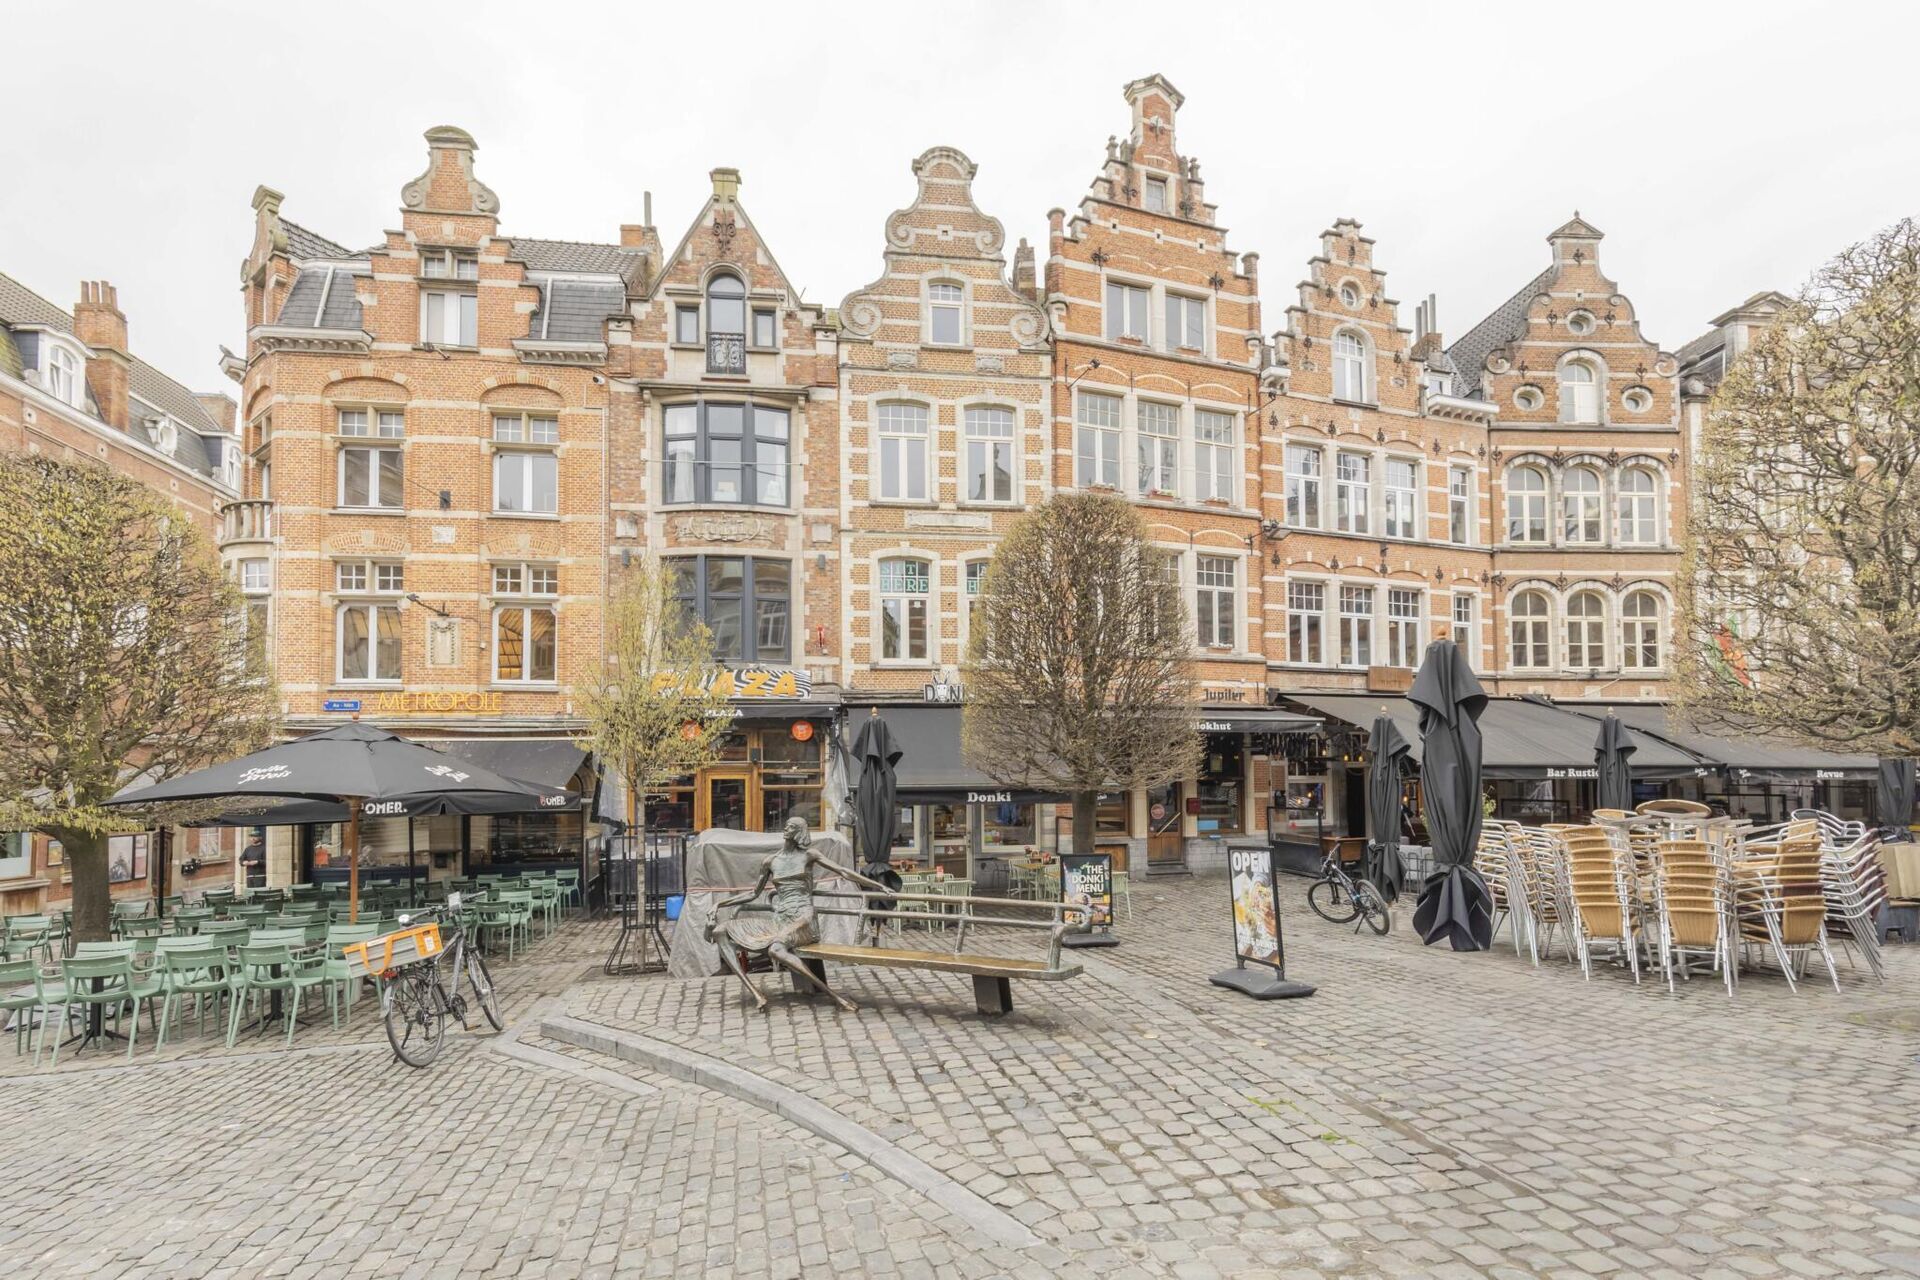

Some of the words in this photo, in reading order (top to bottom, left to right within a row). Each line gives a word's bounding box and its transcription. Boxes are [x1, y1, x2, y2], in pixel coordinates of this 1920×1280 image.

[882, 580, 929, 592] HERE
[1203, 688, 1245, 702] Jupiler
[378, 692, 502, 711] METROPOLE
[1546, 768, 1566, 777] Bar
[1816, 770, 1845, 778] Revue
[967, 792, 1012, 803] Donki
[1232, 851, 1271, 873] OPEN
[1086, 864, 1104, 874] THE
[1072, 874, 1104, 884] DONKI
[1076, 883, 1104, 893] MENU
